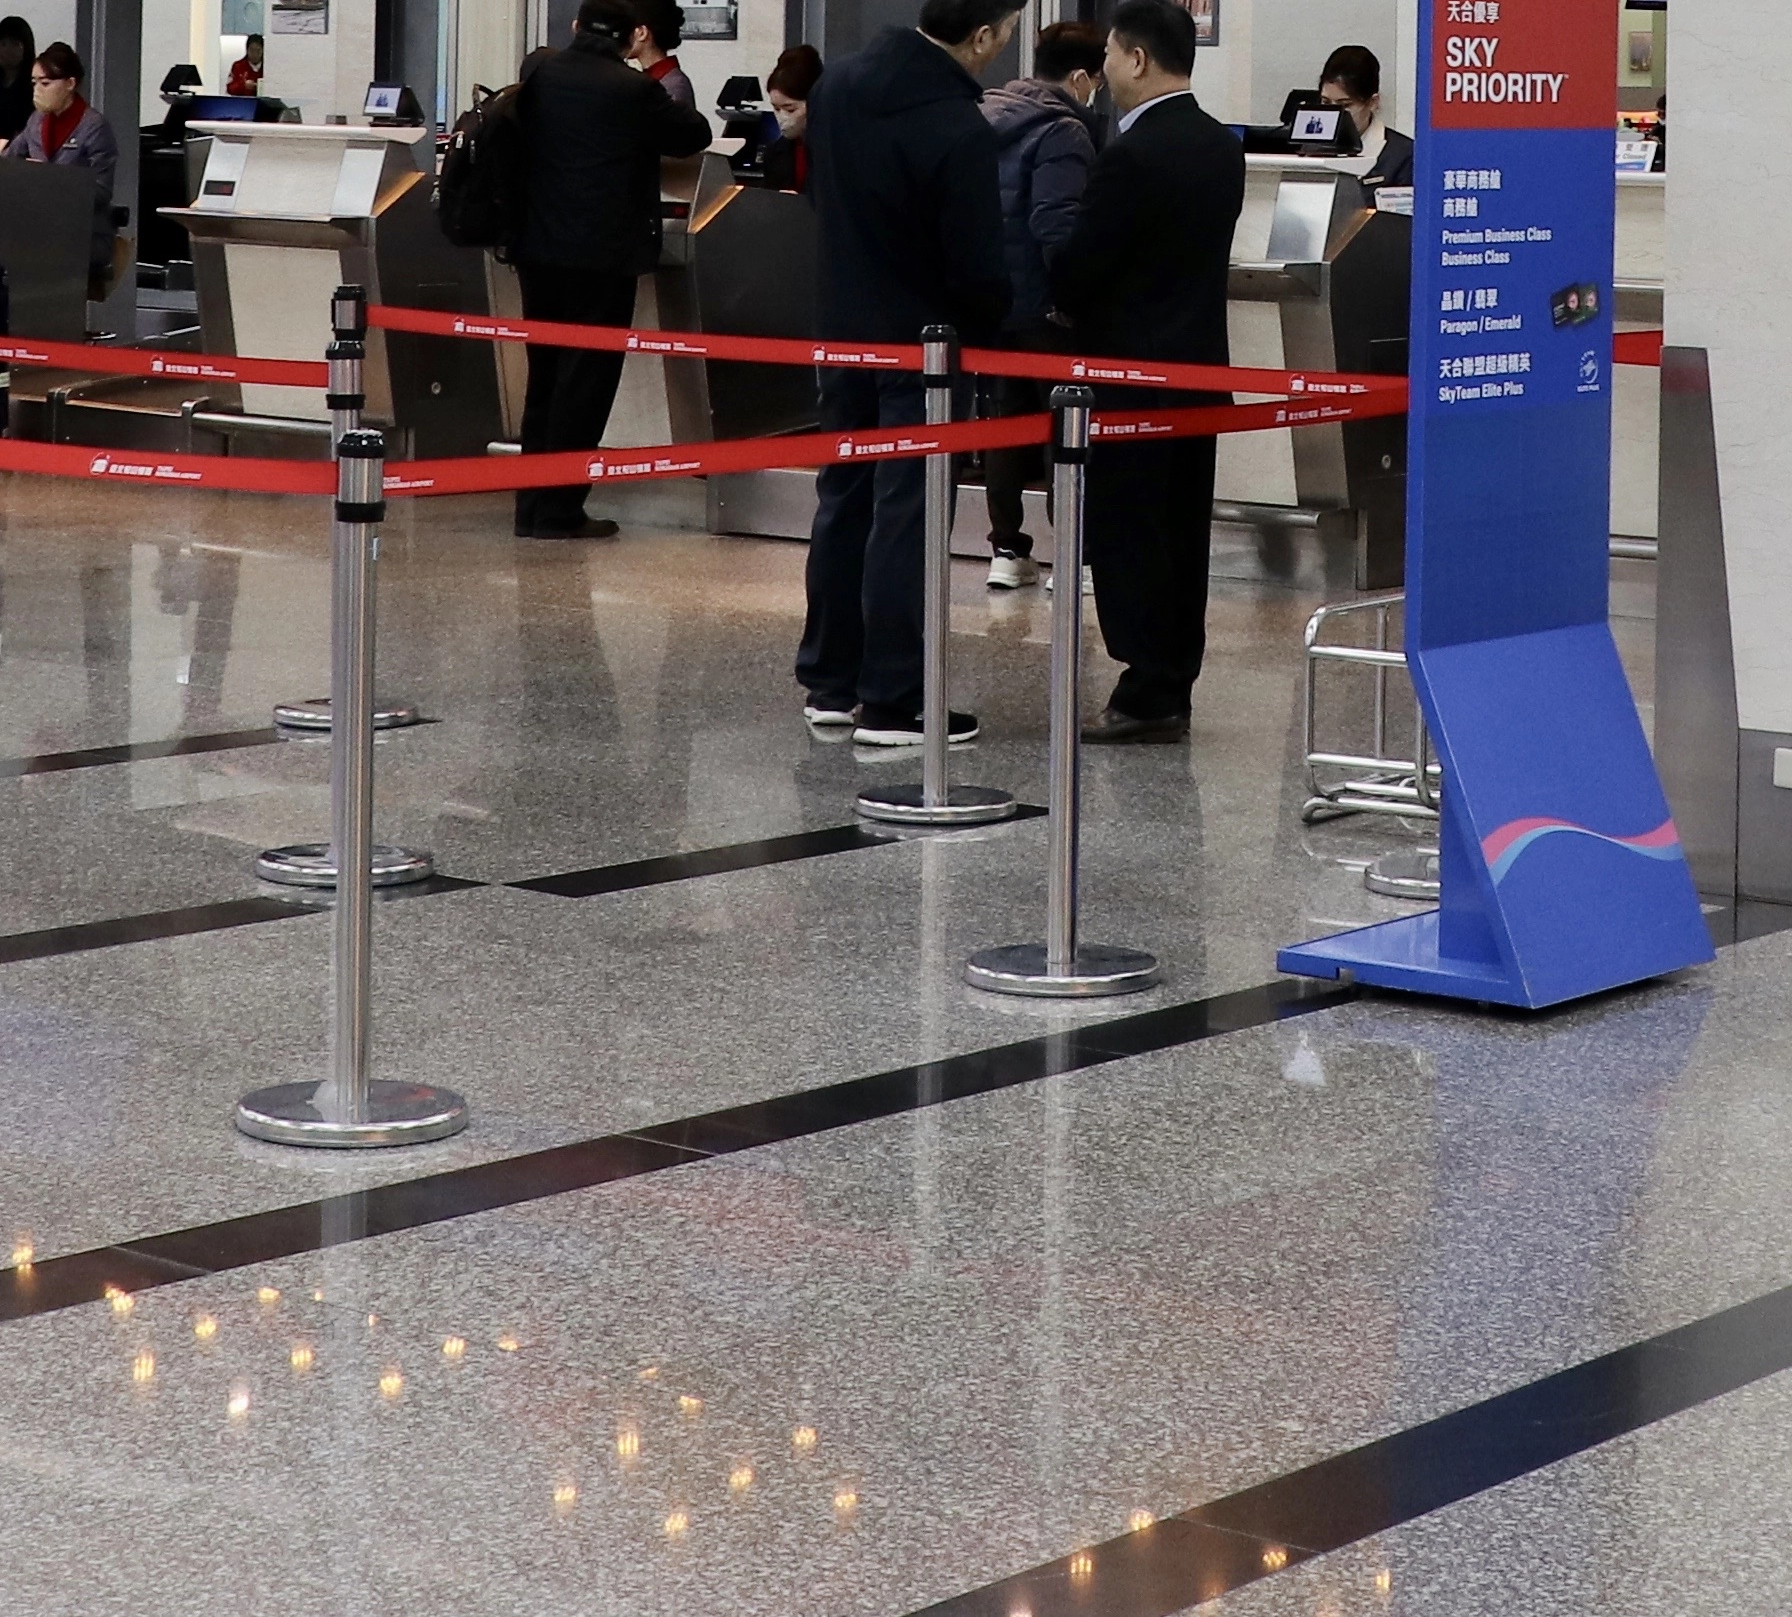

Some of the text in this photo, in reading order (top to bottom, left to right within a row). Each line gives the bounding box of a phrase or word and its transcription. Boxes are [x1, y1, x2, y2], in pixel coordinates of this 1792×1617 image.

[1447, 0, 1500, 24] 天合優享
[1446, 37, 1499, 68] SKY
[1445, 72, 1564, 103] PRIORITY
[1442, 226, 1552, 245] Premium Business Class
[1441, 249, 1510, 266] Business Class
[1439, 319, 1478, 336] Paragon
[1484, 314, 1522, 331] Emerald
[1439, 352, 1531, 379] 天合聯盟超級精英
[1438, 381, 1524, 404] SkyTeam Elite Plus
